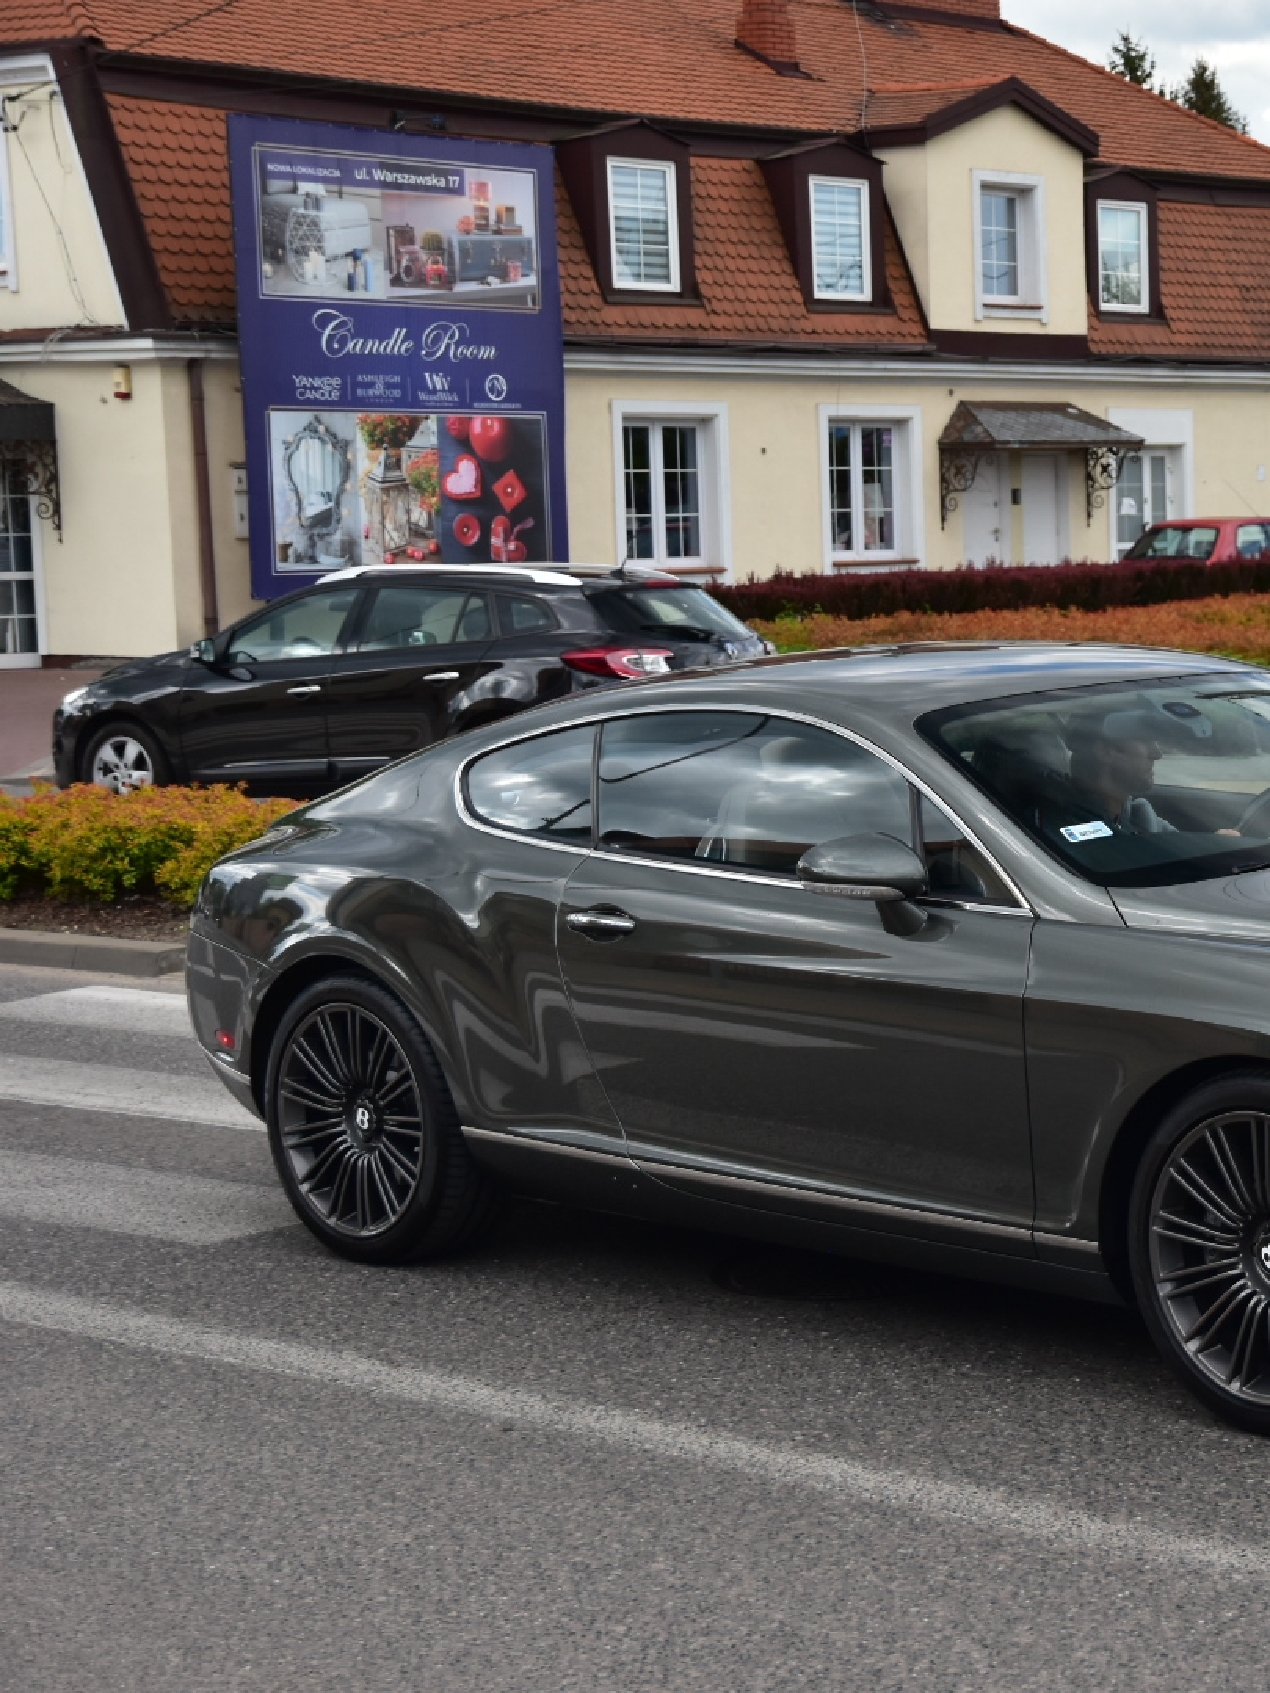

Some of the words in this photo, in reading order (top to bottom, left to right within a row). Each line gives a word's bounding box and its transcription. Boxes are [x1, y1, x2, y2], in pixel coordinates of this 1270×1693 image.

[354, 168, 371, 180] ul.
[372, 168, 445, 187] Warszawska
[447, 175, 461, 188] 17
[312, 309, 415, 358] Candle
[421, 321, 499, 362] Room
